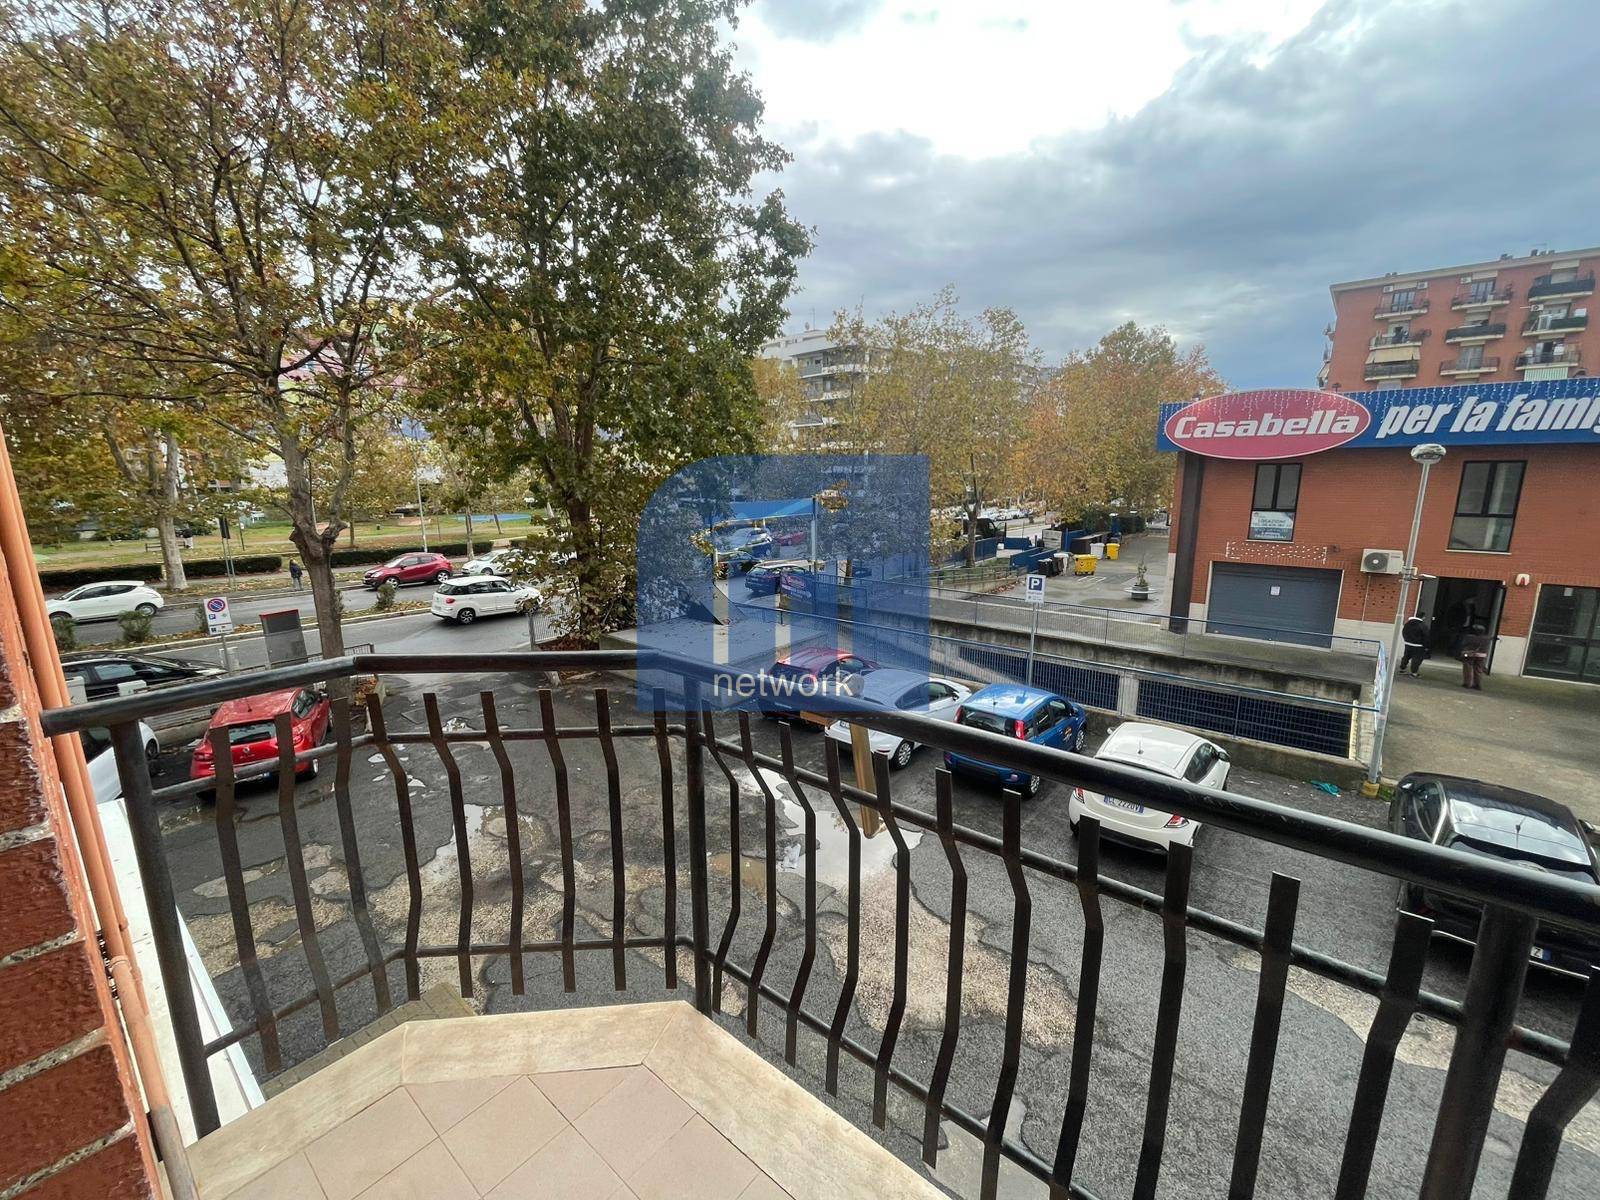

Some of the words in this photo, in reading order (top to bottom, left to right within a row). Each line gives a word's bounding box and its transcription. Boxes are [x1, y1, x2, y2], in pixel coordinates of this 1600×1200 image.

[1174, 410, 1360, 439] Casabella
[1375, 403, 1454, 439] per
[1450, 396, 1499, 433] la
[1496, 394, 1600, 434] fami
